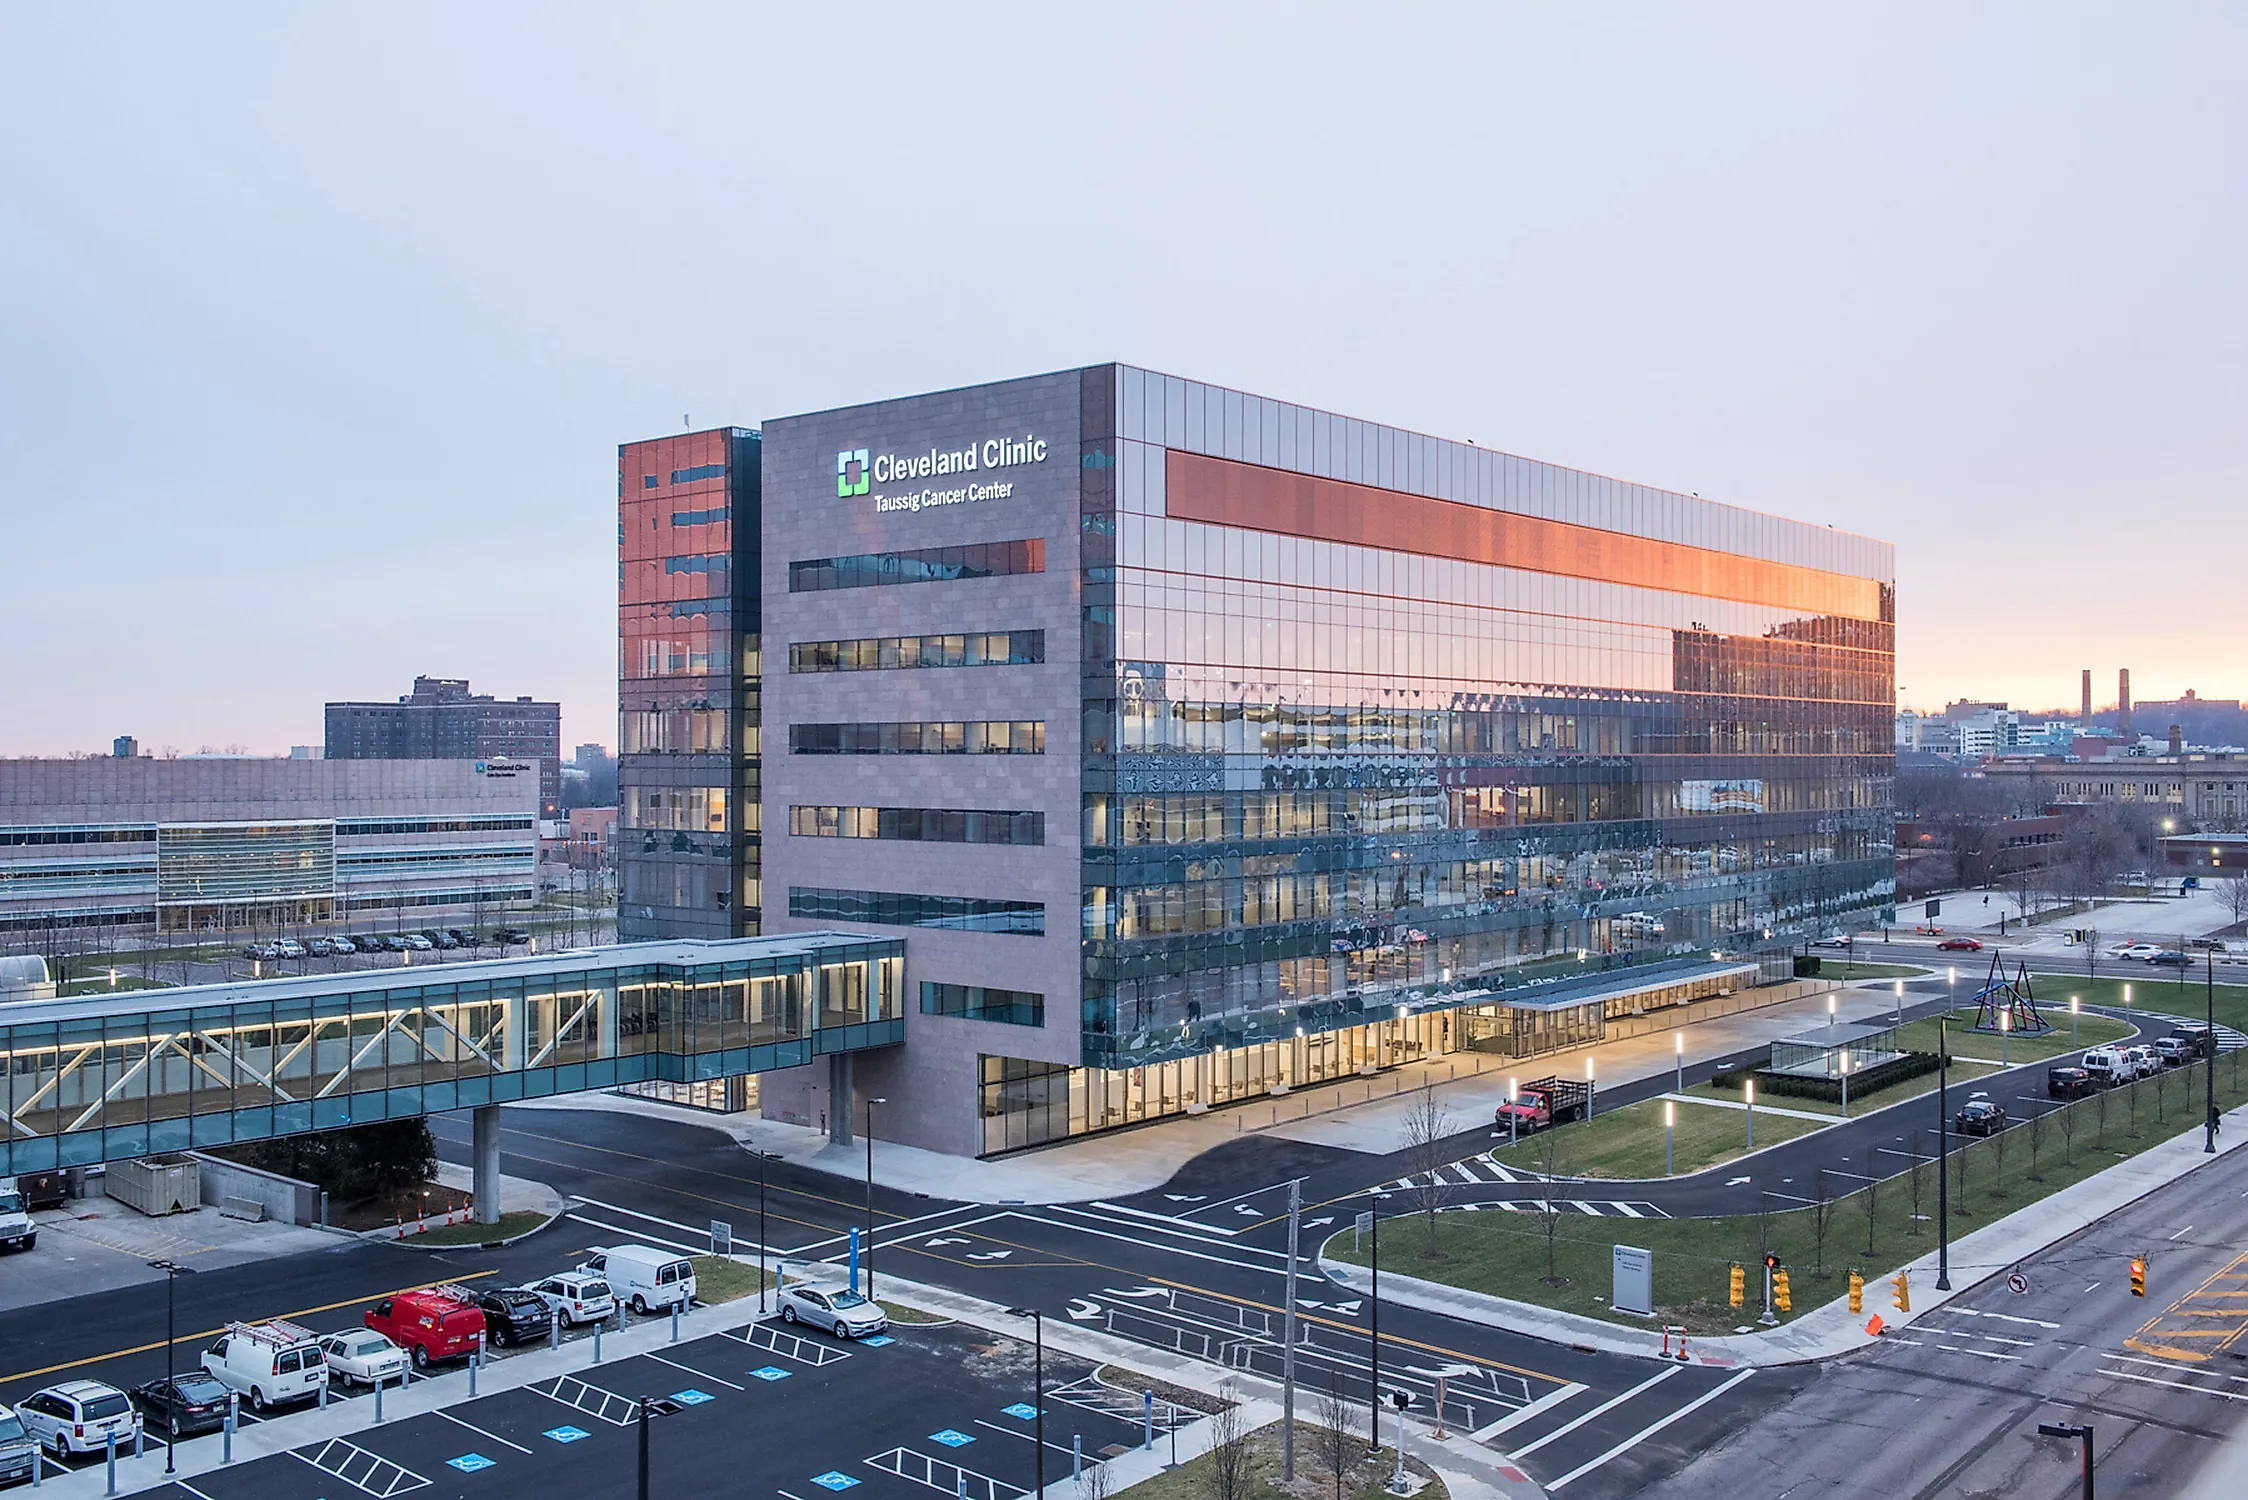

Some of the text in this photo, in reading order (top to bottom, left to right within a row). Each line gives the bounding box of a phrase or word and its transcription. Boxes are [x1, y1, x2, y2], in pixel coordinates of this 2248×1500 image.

[874, 435, 1047, 483] Cleveland Clinic
[874, 482, 1013, 512] Taussig Cancer Center
